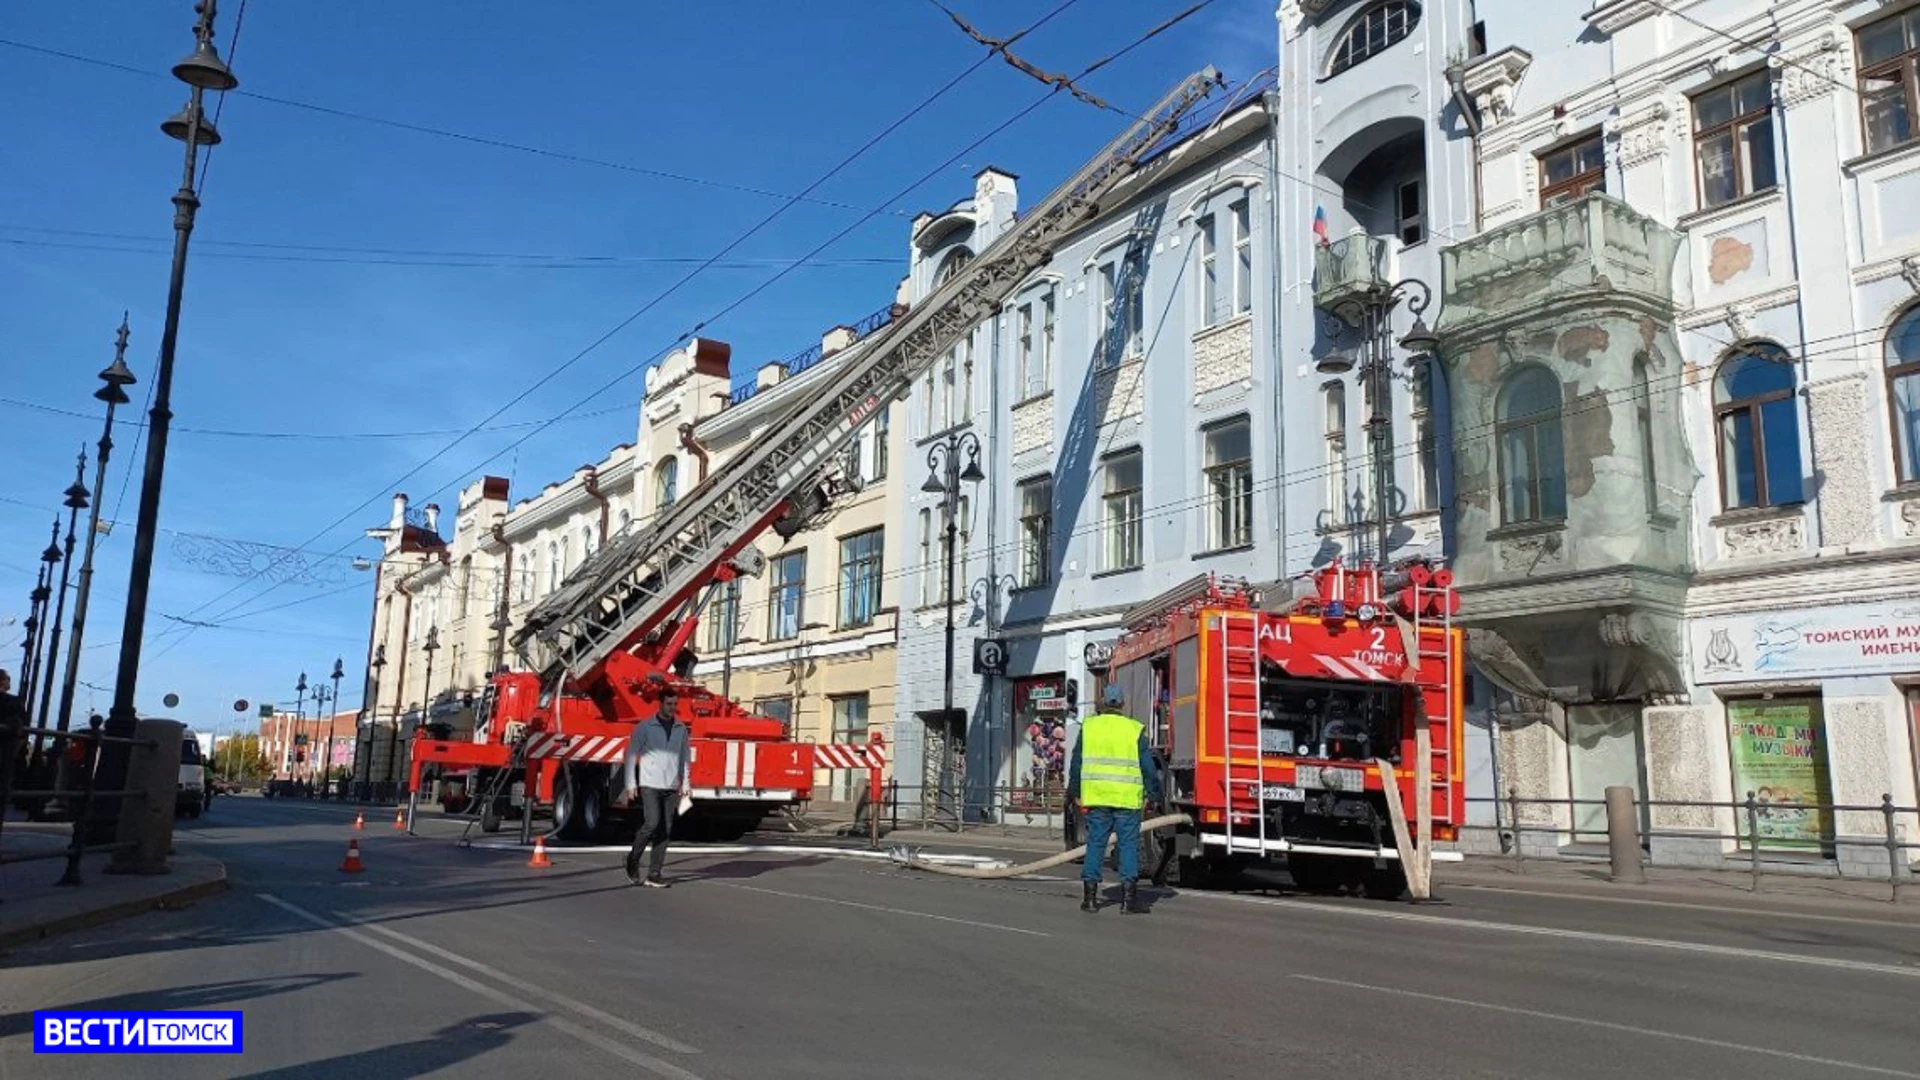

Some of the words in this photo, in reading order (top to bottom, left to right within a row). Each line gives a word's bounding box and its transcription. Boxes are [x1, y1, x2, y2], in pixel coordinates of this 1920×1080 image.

[1259, 623, 1292, 644] АЦ
[1370, 627, 1386, 650] 2
[1803, 625, 1889, 644] ТОМСКИЙ
[1353, 649, 1404, 666] ТОМСК
[791, 749, 799, 765] 1
